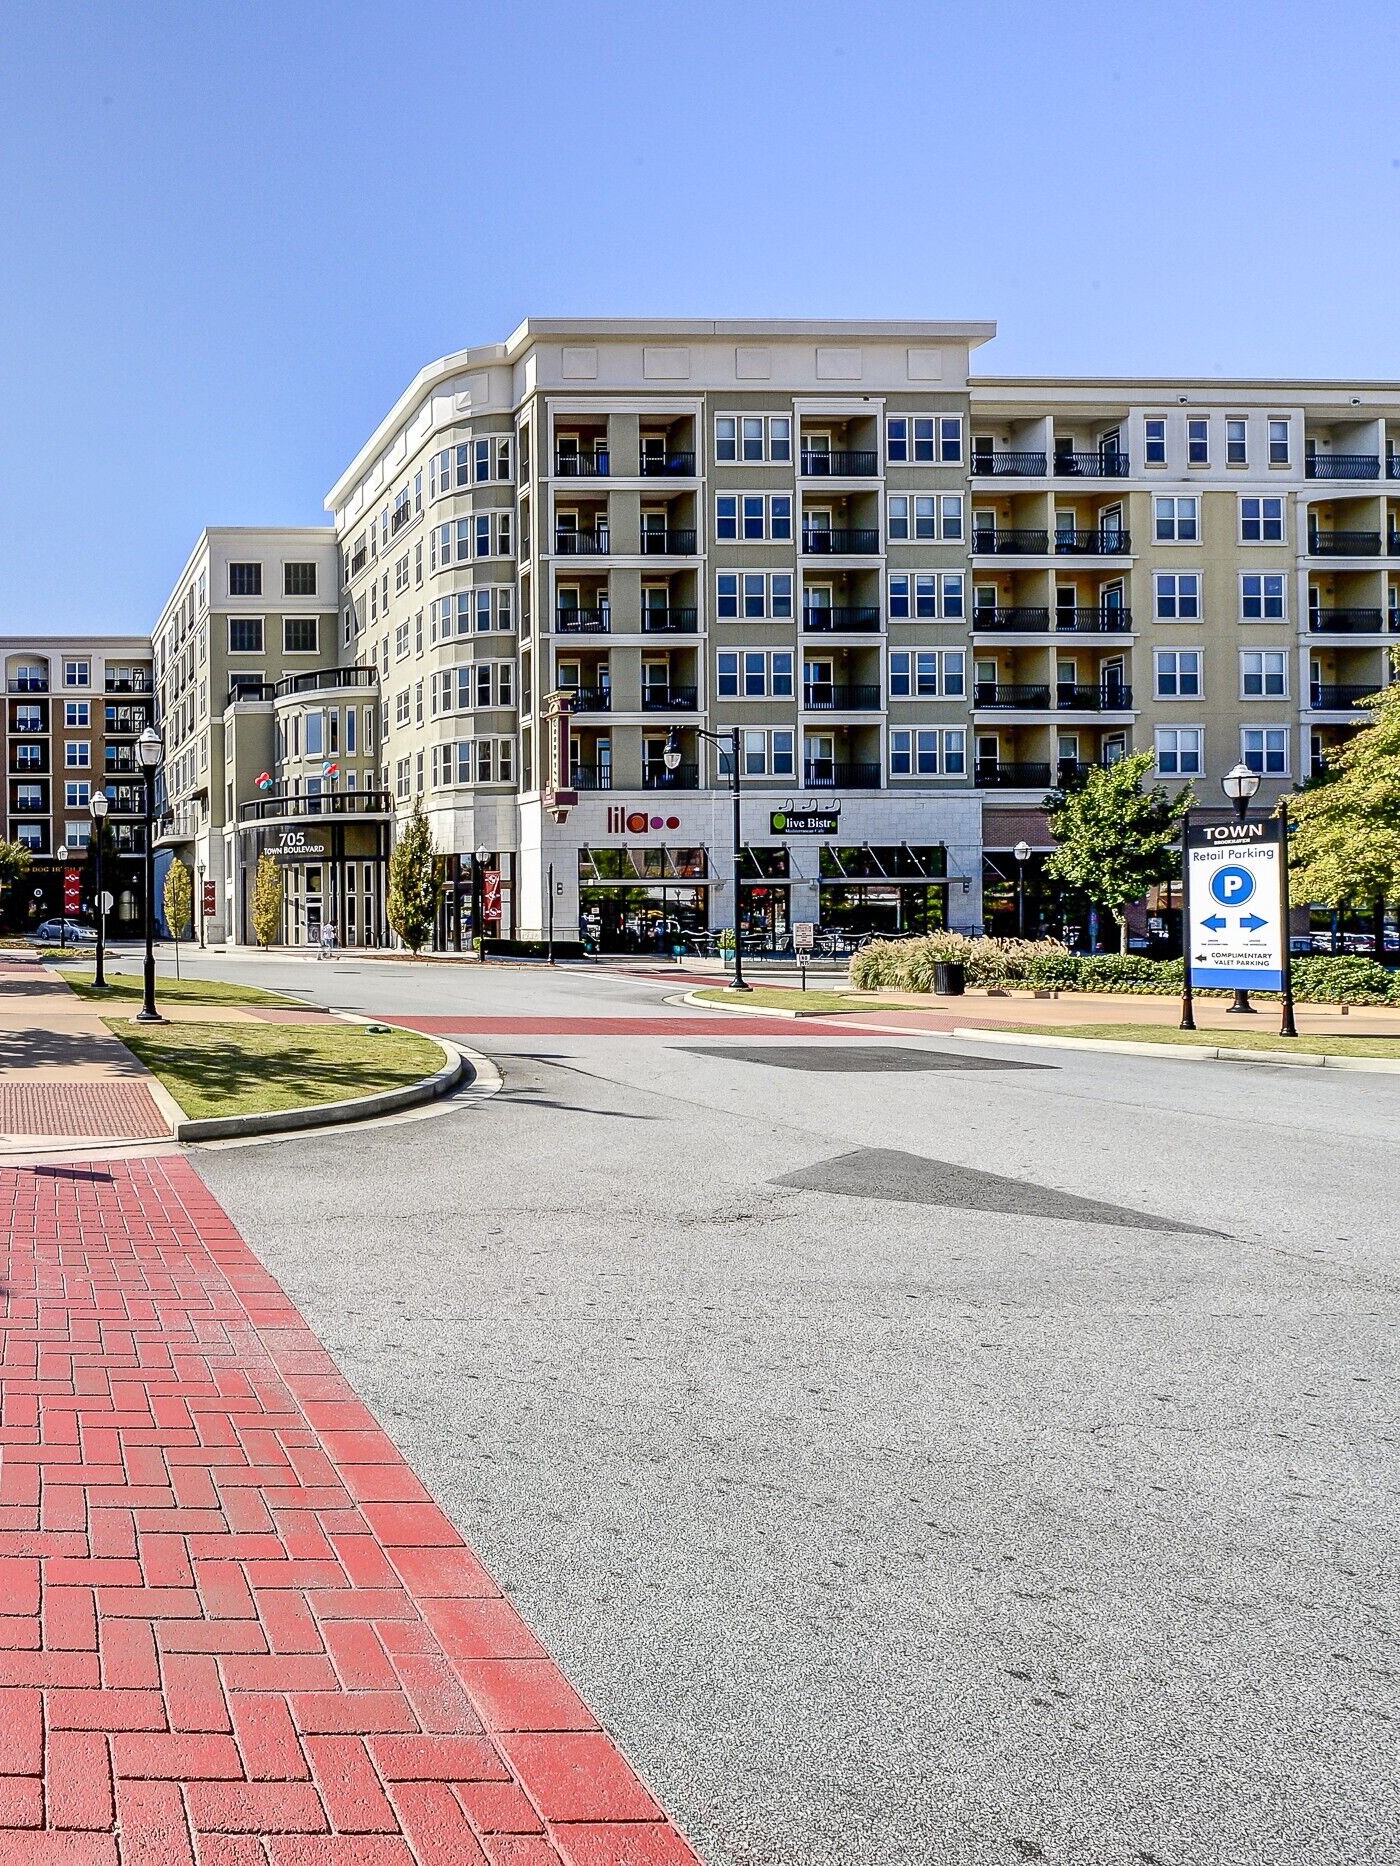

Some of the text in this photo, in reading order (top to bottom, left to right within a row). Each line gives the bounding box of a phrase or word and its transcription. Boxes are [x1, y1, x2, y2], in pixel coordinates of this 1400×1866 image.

[607, 806, 649, 833] lila
[807, 817, 837, 828] Bistro
[1203, 823, 1263, 840] TOWN
[279, 832, 305, 847] 705
[264, 845, 325, 856] TOWN BOULEVARD
[1193, 847, 1274, 861] Retail Parking
[1223, 875, 1243, 897] P
